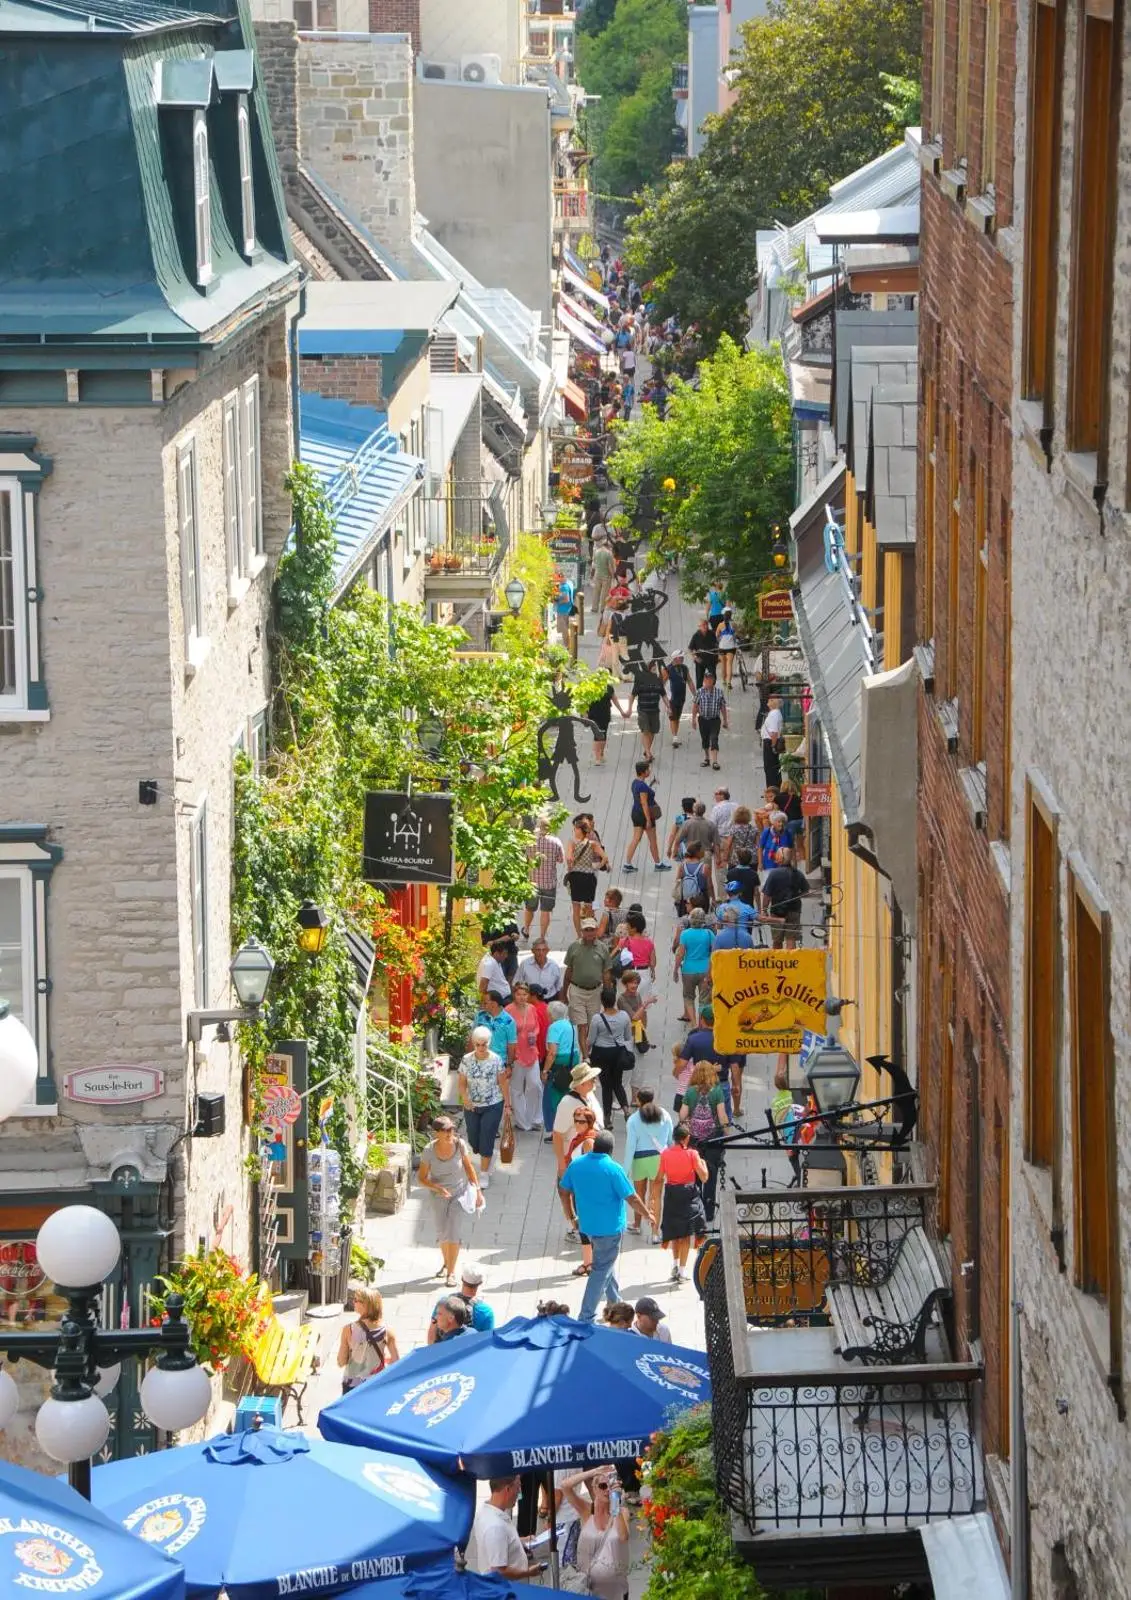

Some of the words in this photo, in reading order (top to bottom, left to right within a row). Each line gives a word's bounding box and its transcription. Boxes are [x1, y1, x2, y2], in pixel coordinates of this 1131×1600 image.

[738, 953, 799, 973] boutique
[714, 979, 770, 1010] Louis
[772, 975, 826, 1013] Jolliet
[735, 1035, 804, 1049] souvenirs
[84, 1081, 144, 1092] Sous-le-Fort
[643, 1353, 711, 1380] CHAMBL
[511, 1444, 574, 1469] BLANCHE
[586, 1439, 643, 1462] CHAMBLY
[276, 1565, 339, 1596] BLANCHE
[351, 1555, 407, 1579] CHAMBLY
